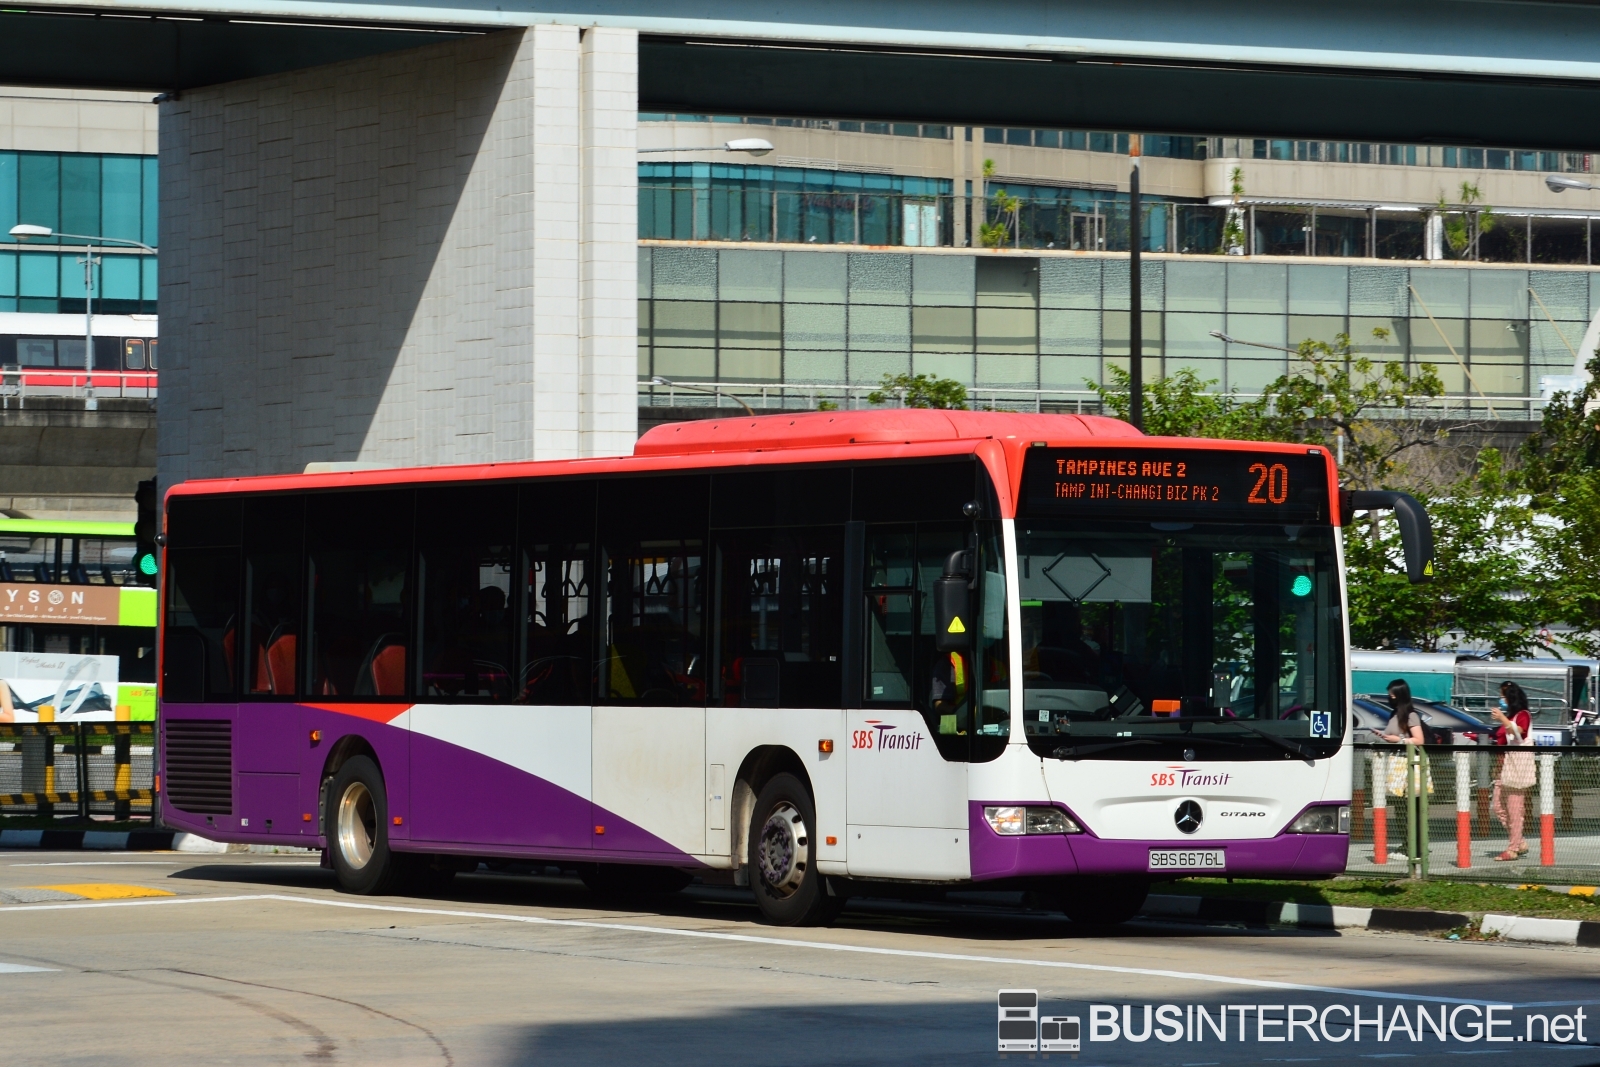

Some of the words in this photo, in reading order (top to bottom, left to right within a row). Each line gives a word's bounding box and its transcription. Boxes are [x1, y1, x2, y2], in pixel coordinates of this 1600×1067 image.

[1056, 459, 1137, 477] TAMPINES
[1142, 461, 1172, 478] AVE
[1177, 462, 1186, 478] 2
[1055, 482, 1086, 499] TAMP
[1090, 483, 1162, 501] INT-CHANGI
[1166, 484, 1188, 501] BIZ
[1192, 485, 1208, 501] PK
[1211, 486, 1219, 502] 2
[1247, 462, 1288, 504] 20
[852, 730, 873, 749] SBS
[872, 724, 925, 753] Transit
[1150, 772, 1175, 786] SBS
[1175, 768, 1234, 788] Transit
